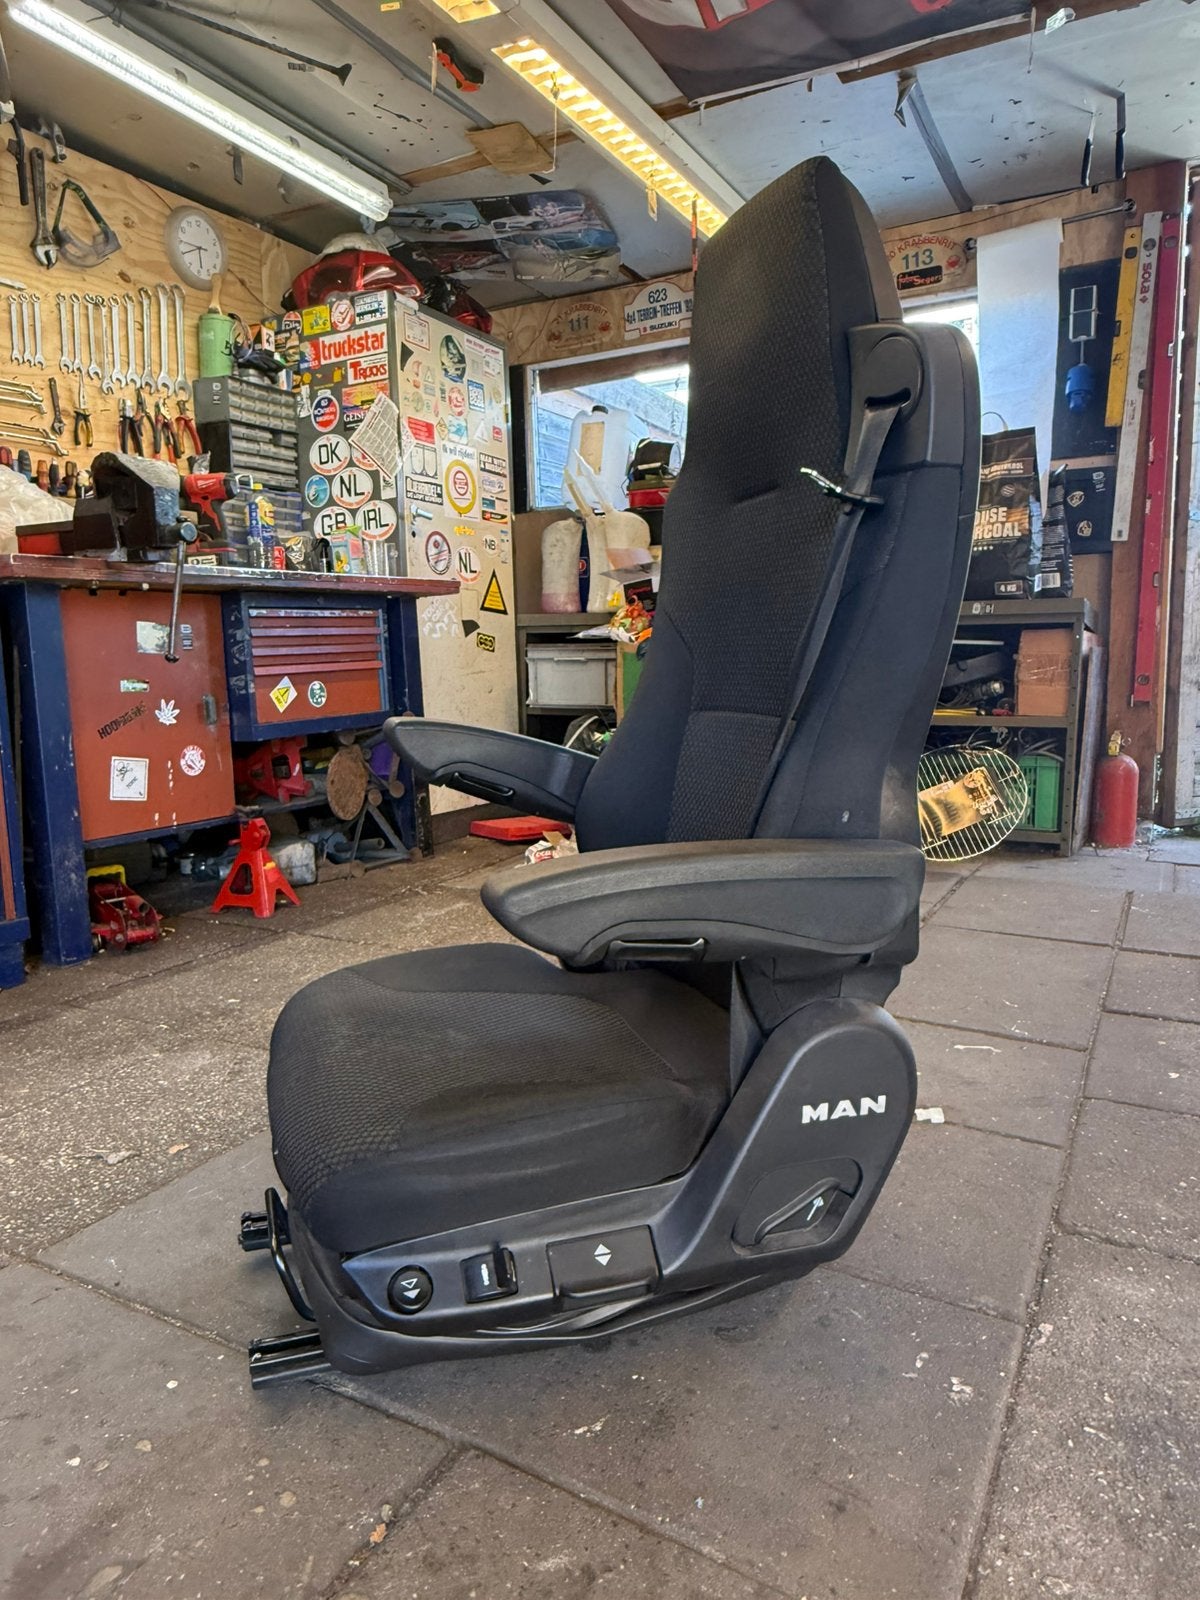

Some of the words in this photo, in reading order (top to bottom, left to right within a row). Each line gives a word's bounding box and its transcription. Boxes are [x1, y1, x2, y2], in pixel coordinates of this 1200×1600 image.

[902, 248, 934, 270] 113
[648, 288, 668, 304] 623
[626, 311, 636, 324] 4x4
[637, 301, 683, 322] TERREIN-TREFFEN
[650, 321, 678, 331] SUZUKI
[321, 331, 385, 360] truckstar
[318, 441, 342, 465] DK
[340, 474, 365, 498] NL
[321, 512, 347, 536] GB
[363, 507, 390, 531] IRL
[458, 551, 477, 574] NL
[802, 1095, 886, 1124] MAN
